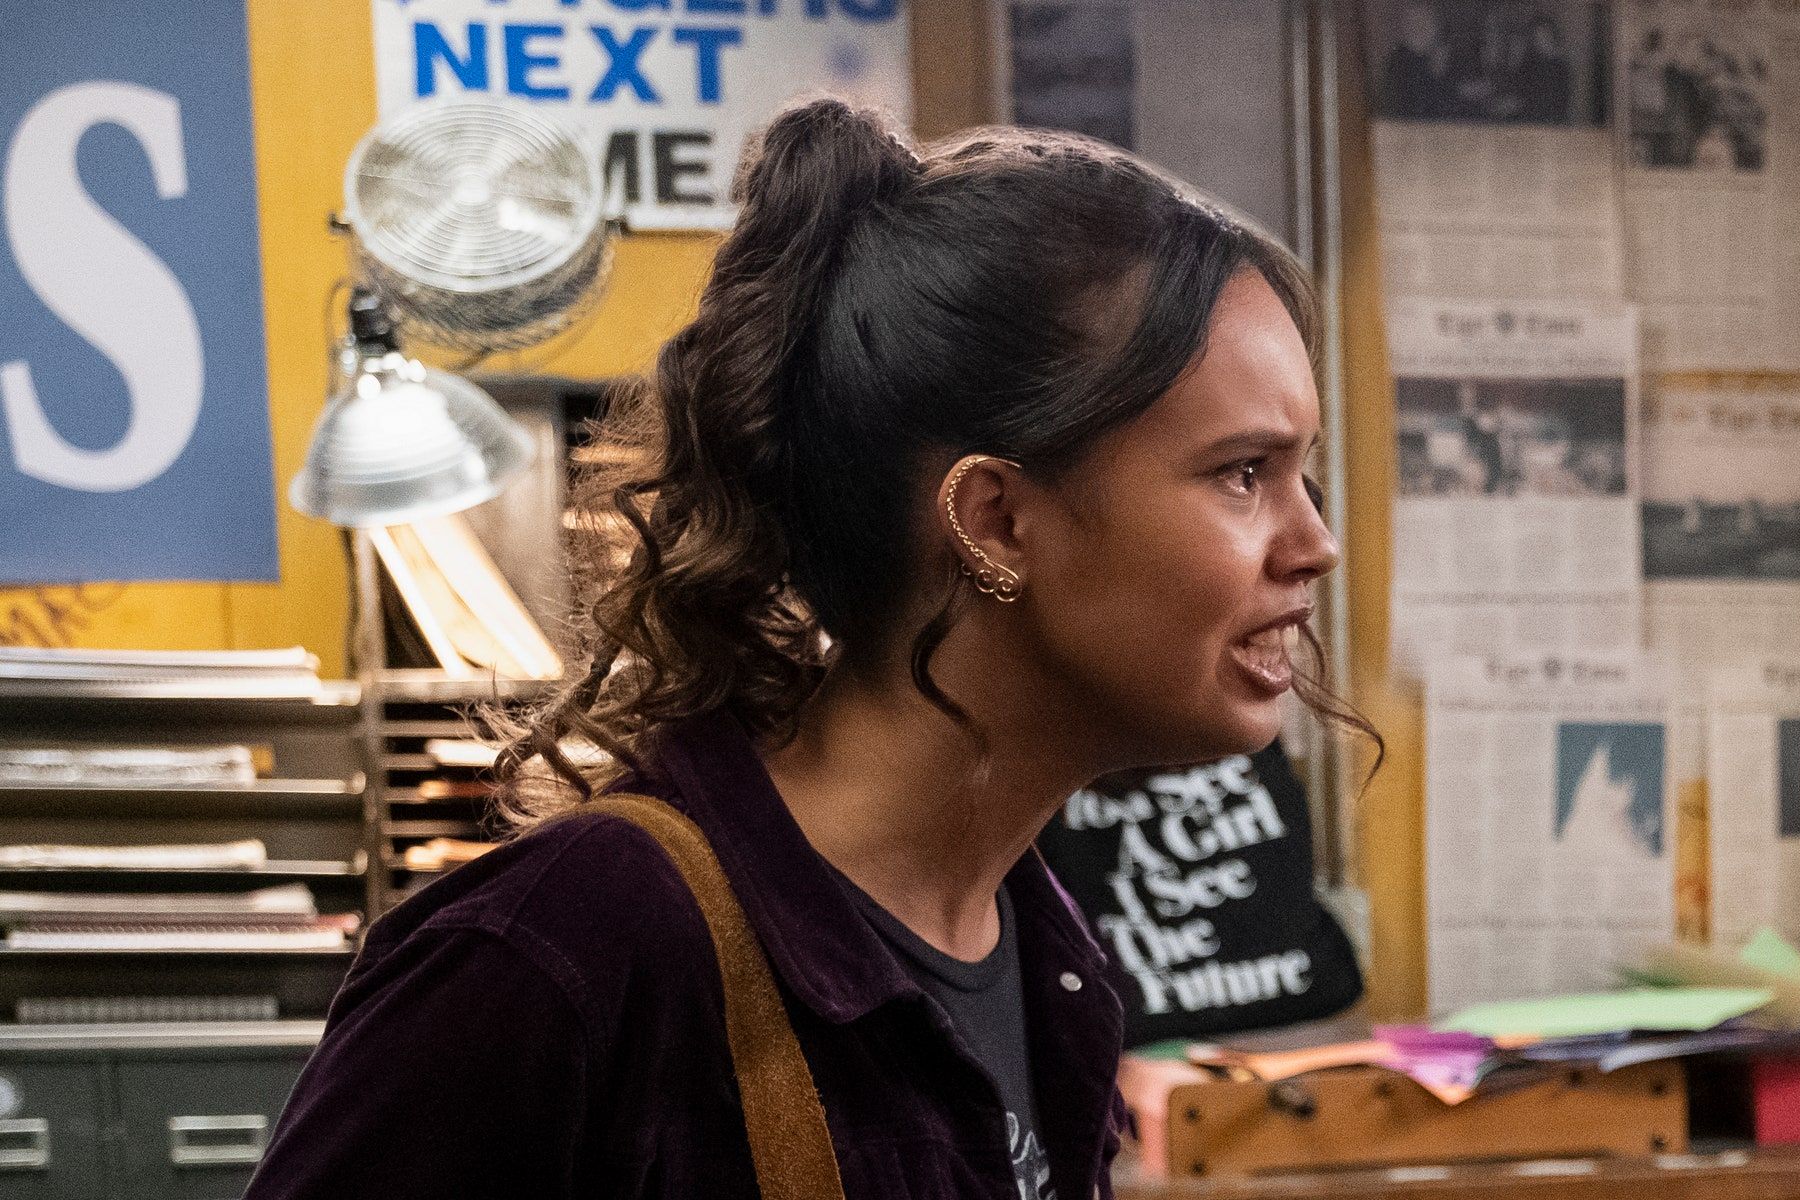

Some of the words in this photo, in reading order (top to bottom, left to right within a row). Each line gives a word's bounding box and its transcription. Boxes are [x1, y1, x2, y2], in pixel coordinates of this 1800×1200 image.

[413, 22, 744, 104] NEXT
[602, 131, 713, 205] ME
[2, 80, 203, 493] S
[1159, 784, 1287, 861] Girl
[1145, 858, 1257, 918] See
[1097, 915, 1221, 975] The
[1138, 949, 1313, 1015] Future
